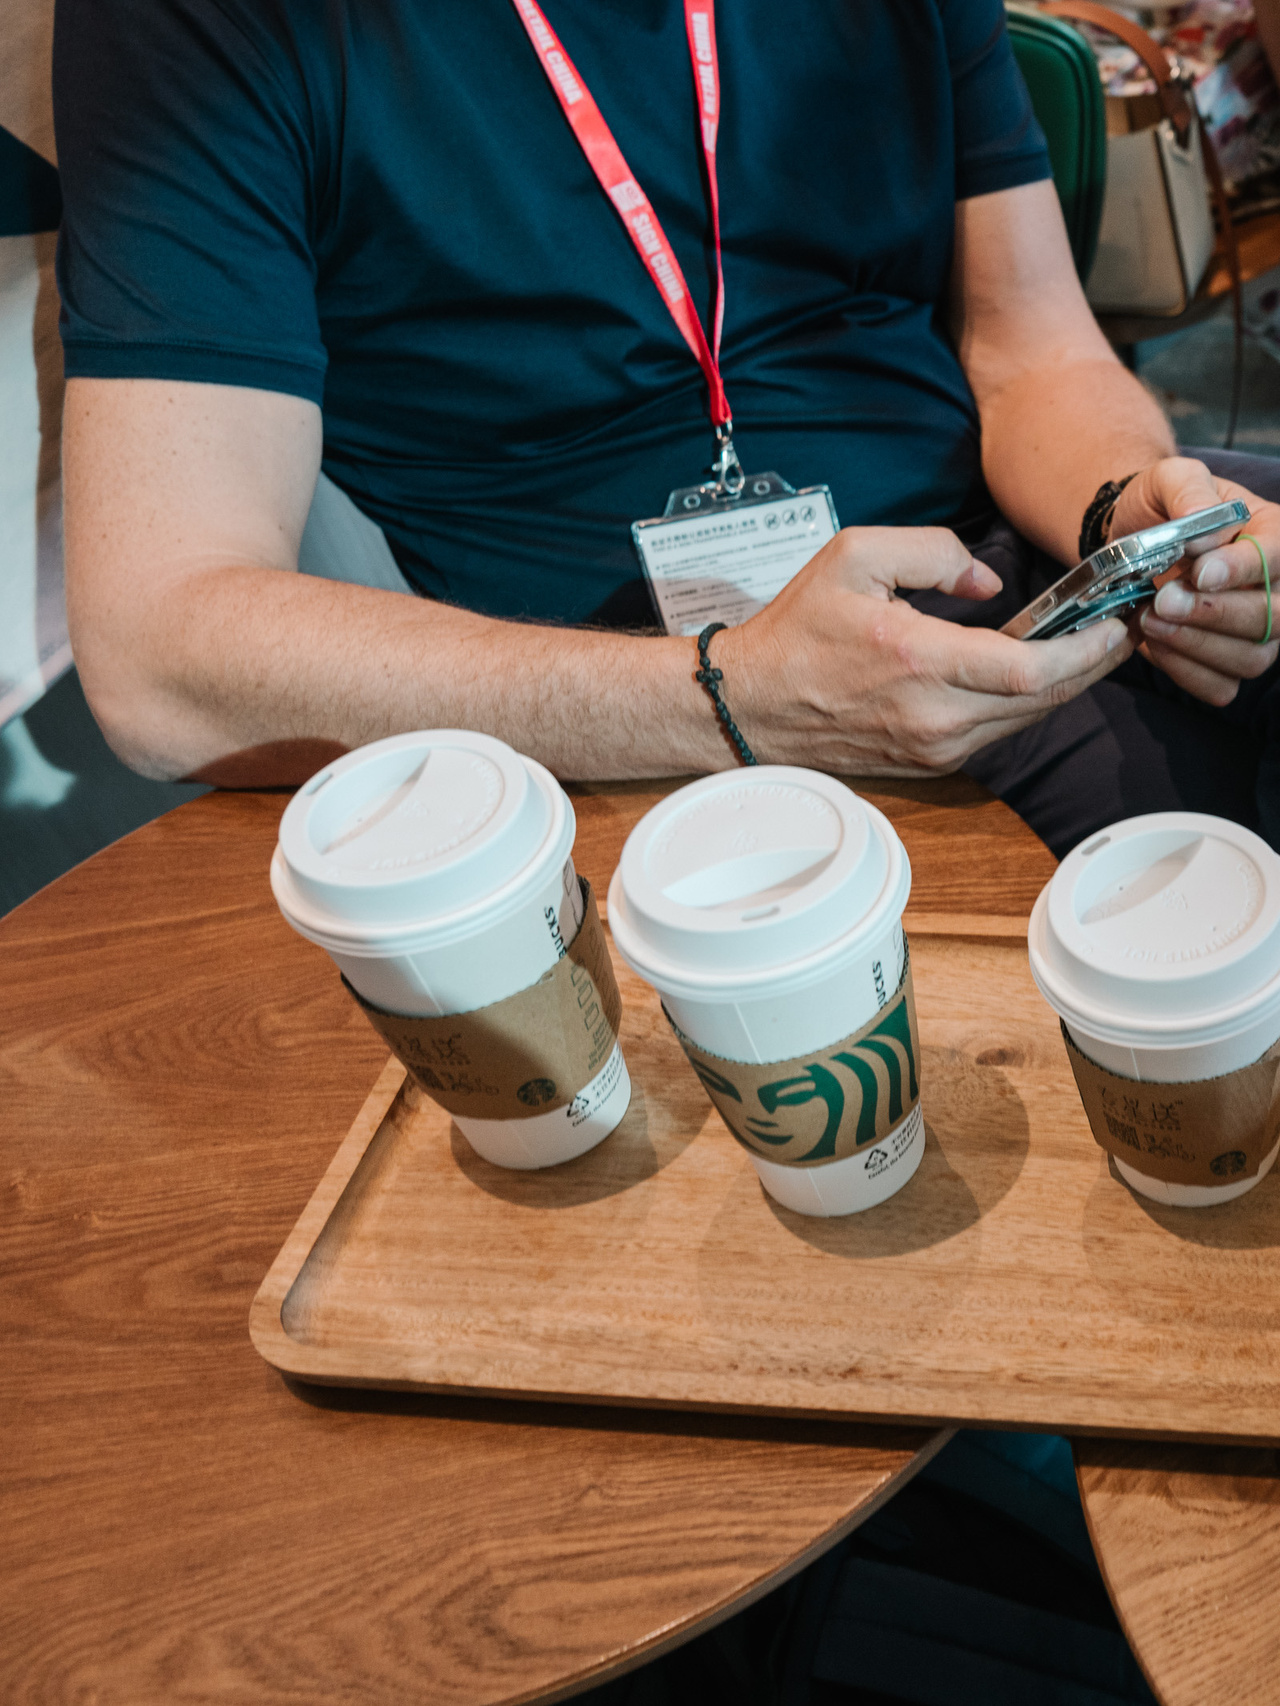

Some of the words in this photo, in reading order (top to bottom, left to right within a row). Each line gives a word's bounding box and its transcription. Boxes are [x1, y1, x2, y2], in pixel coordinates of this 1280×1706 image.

[691, 12, 713, 64] CHINA
[546, 50, 584, 106] CHINA
[631, 212, 662, 256] SIGN
[650, 252, 685, 304] CHINA
